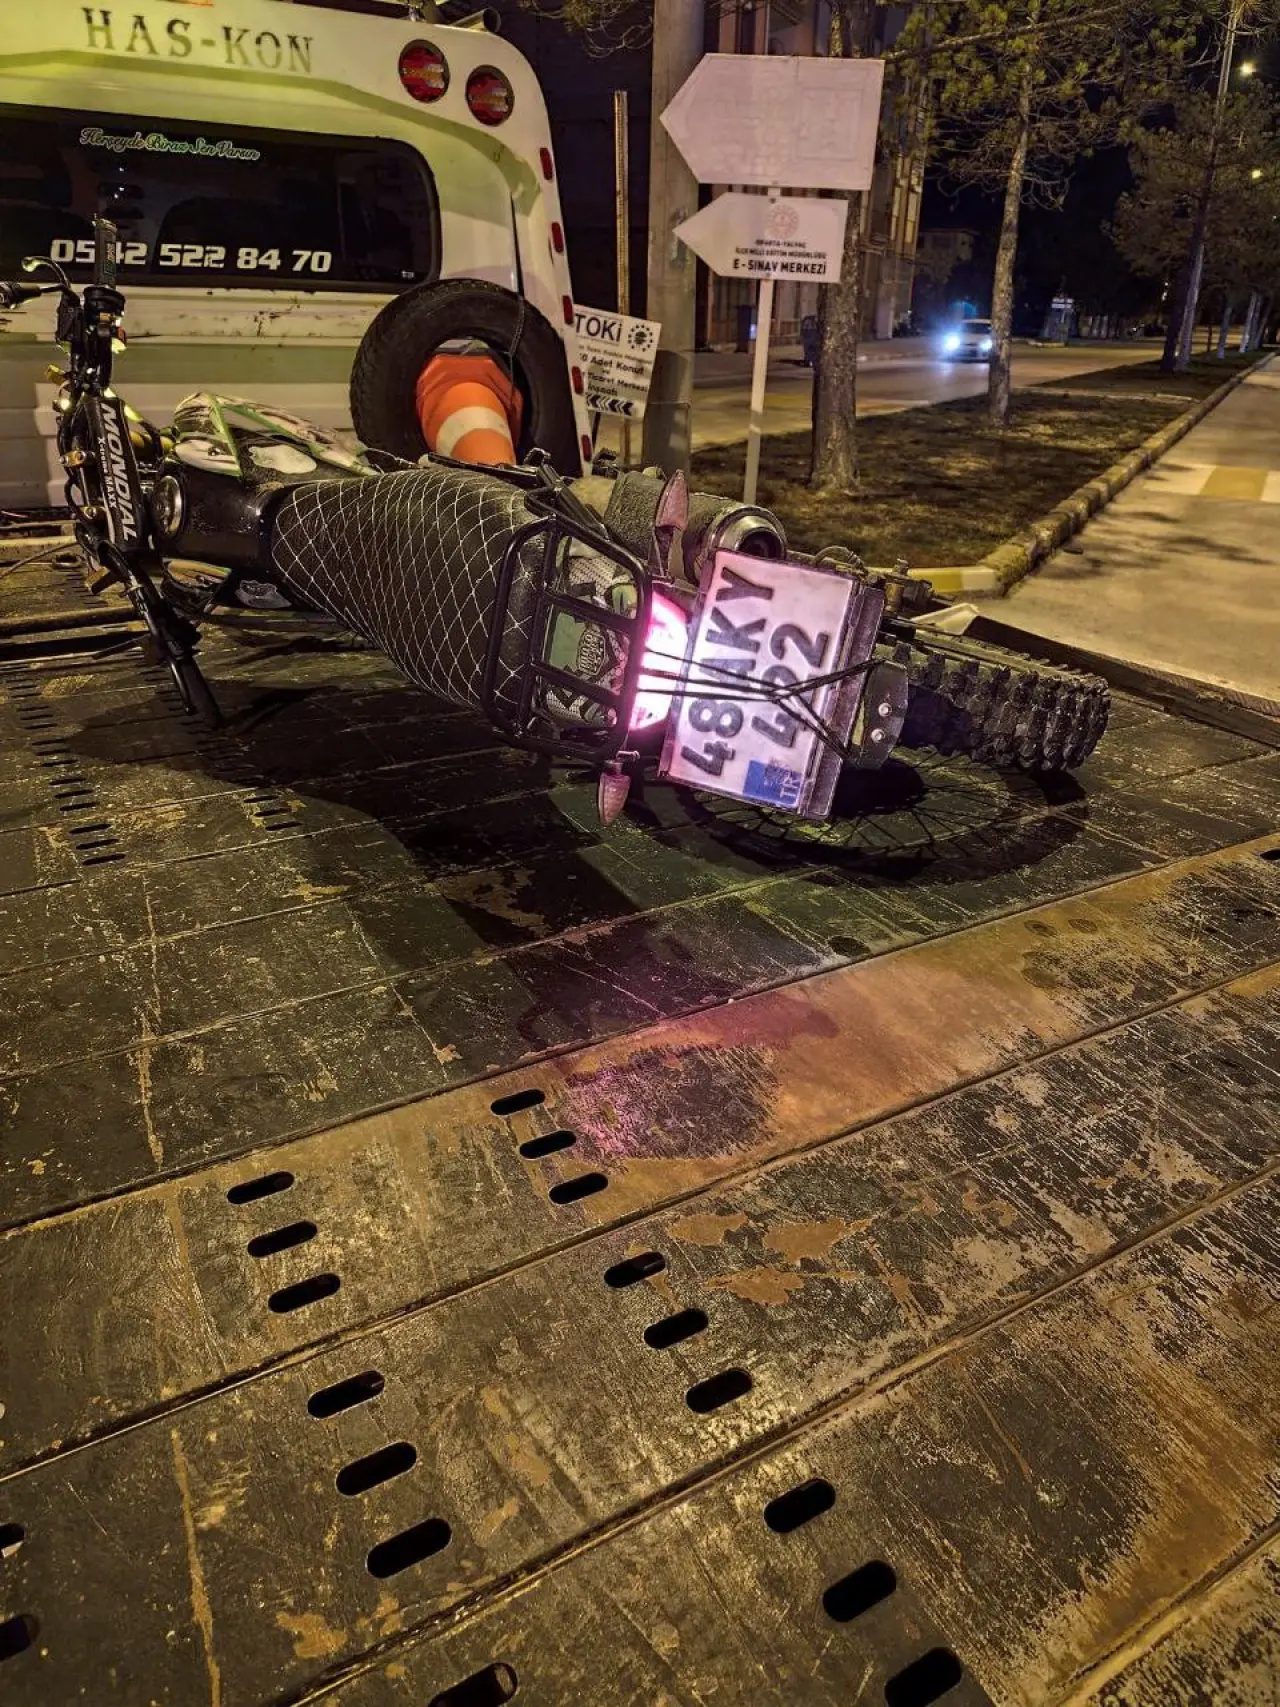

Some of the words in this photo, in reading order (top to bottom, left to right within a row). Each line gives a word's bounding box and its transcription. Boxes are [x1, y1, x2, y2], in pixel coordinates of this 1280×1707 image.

[82, 7, 313, 73] HAS-KON
[160, 243, 225, 269] 522
[237, 247, 281, 271] 84
[292, 250, 332, 273] 70
[780, 261, 827, 275] MERKEZİ
[100, 402, 138, 542] MONDIAL
[104, 474, 117, 509] MAXX
[779, 772, 801, 799] TR
